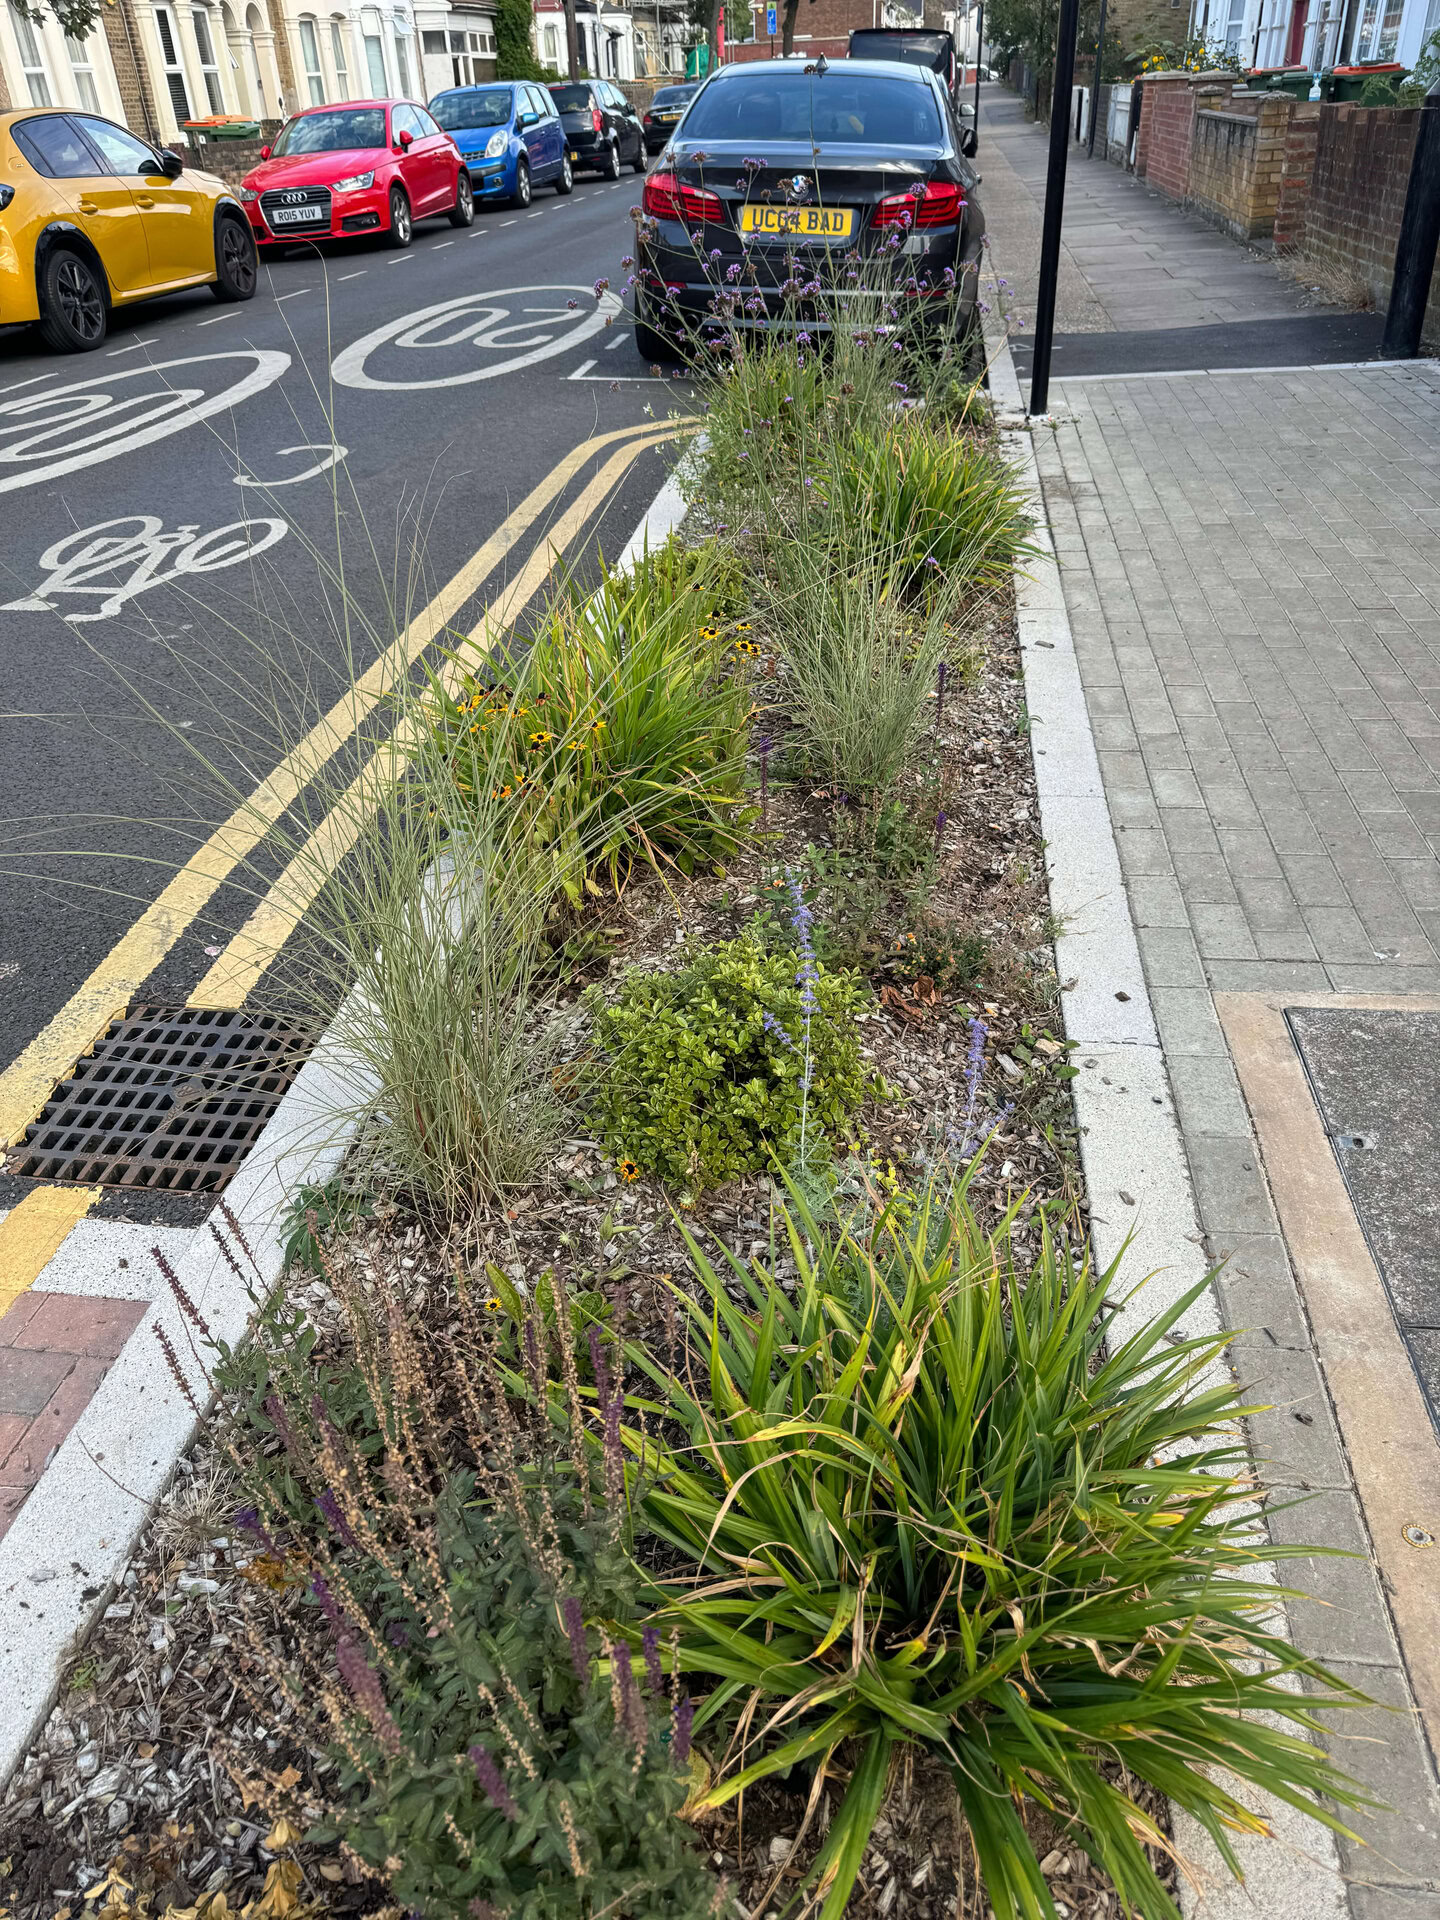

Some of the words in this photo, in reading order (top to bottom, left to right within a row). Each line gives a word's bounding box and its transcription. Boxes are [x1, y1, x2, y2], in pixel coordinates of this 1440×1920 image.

[299, 208, 316, 219] YUV
[807, 211, 844, 231] BAD
[394, 307, 588, 349] 20
